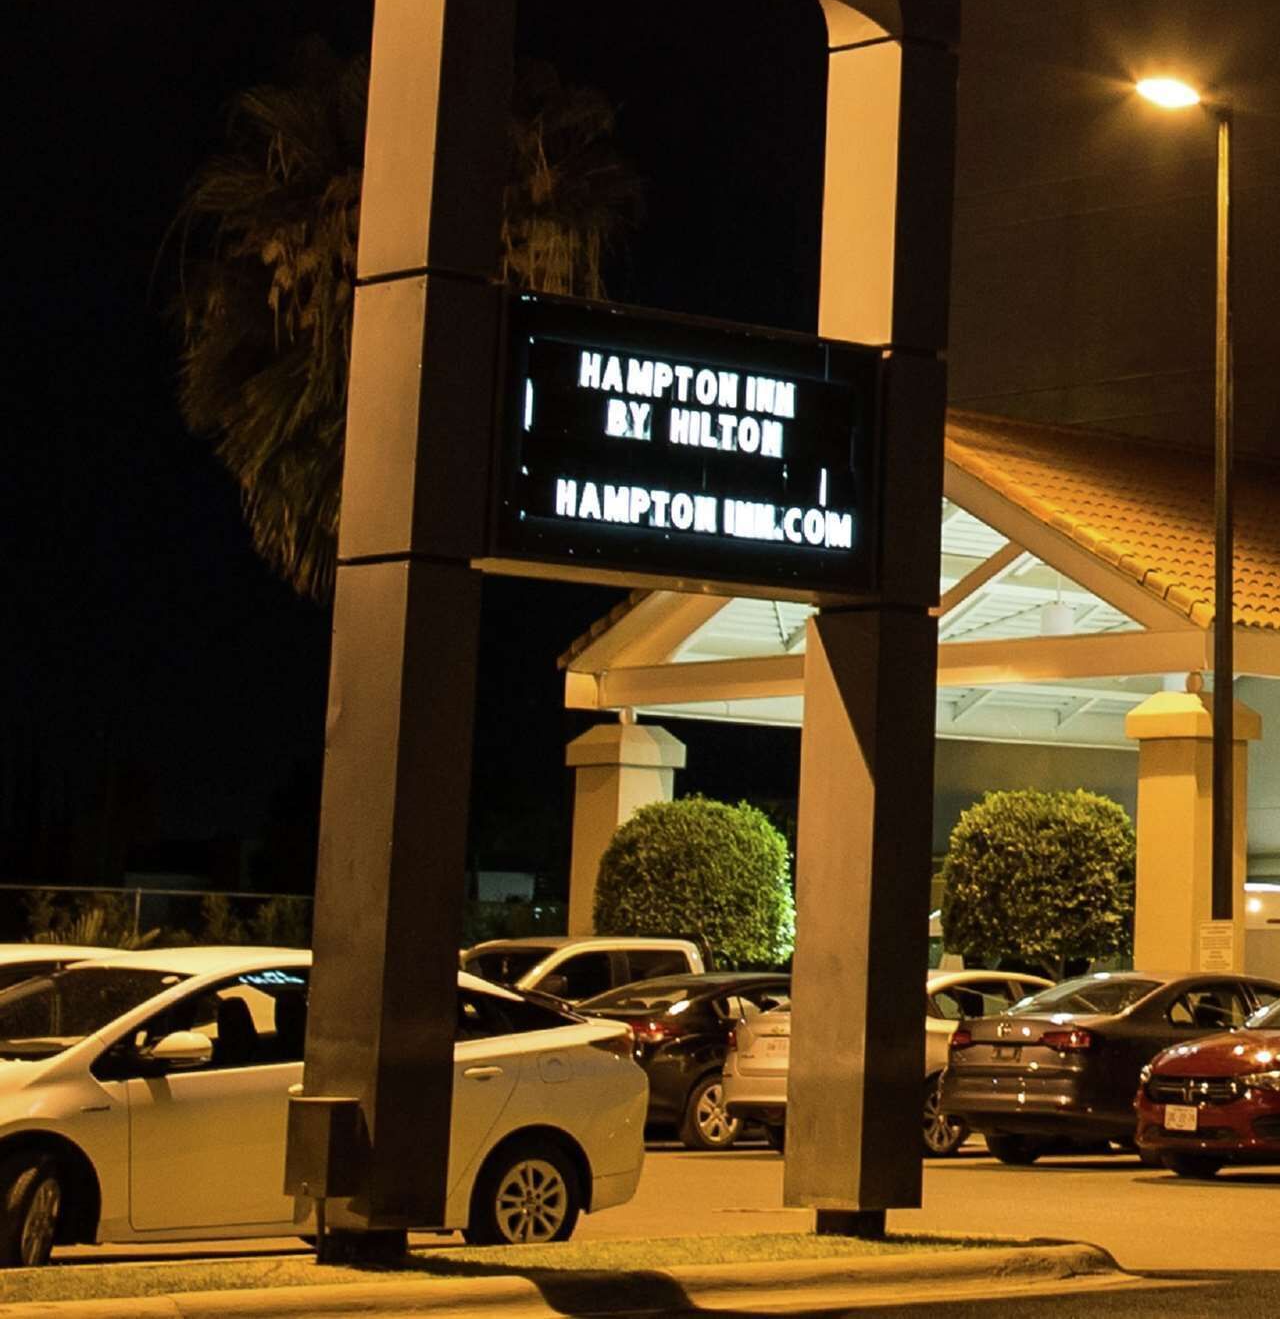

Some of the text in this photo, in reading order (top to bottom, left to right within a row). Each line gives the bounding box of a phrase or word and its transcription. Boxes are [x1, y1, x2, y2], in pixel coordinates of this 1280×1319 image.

[578, 351, 797, 418] HAMPTON INN
[605, 399, 783, 458] BY HILTON
[555, 478, 717, 534] HAMPTON
